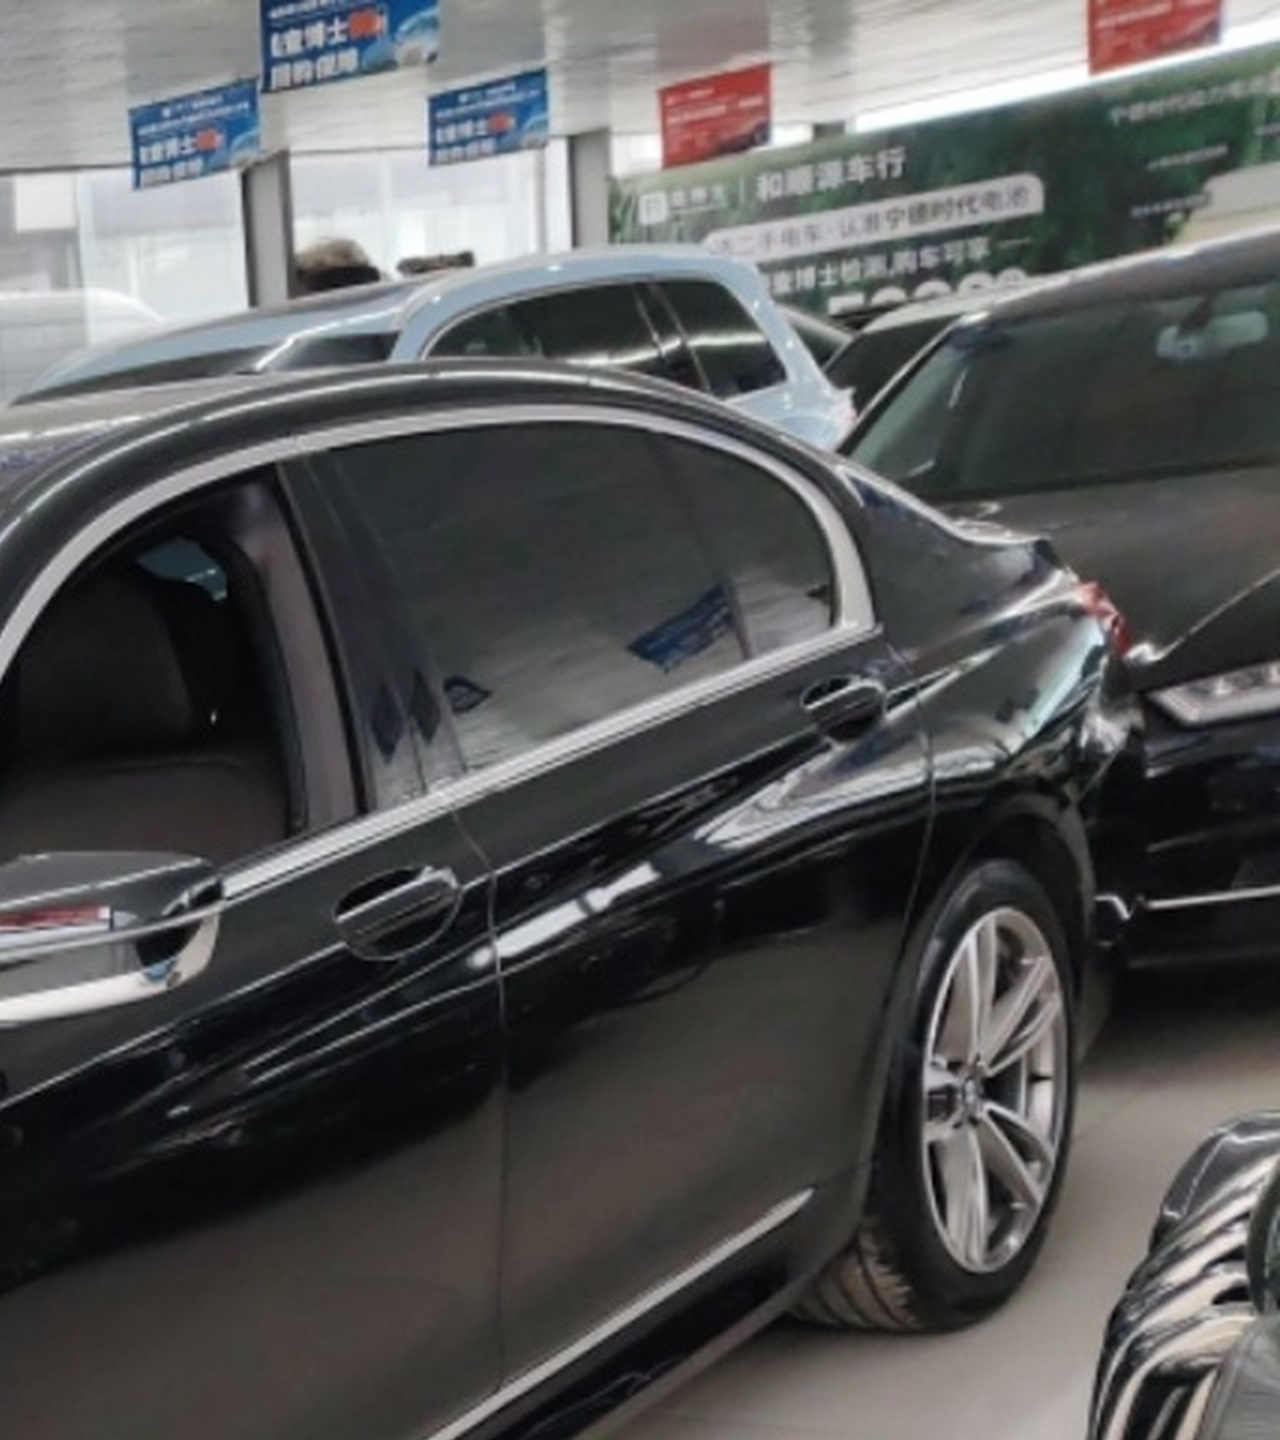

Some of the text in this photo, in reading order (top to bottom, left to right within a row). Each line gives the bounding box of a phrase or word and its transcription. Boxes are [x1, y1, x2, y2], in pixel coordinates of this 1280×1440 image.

[757, 146, 905, 201] 和顺源车行
